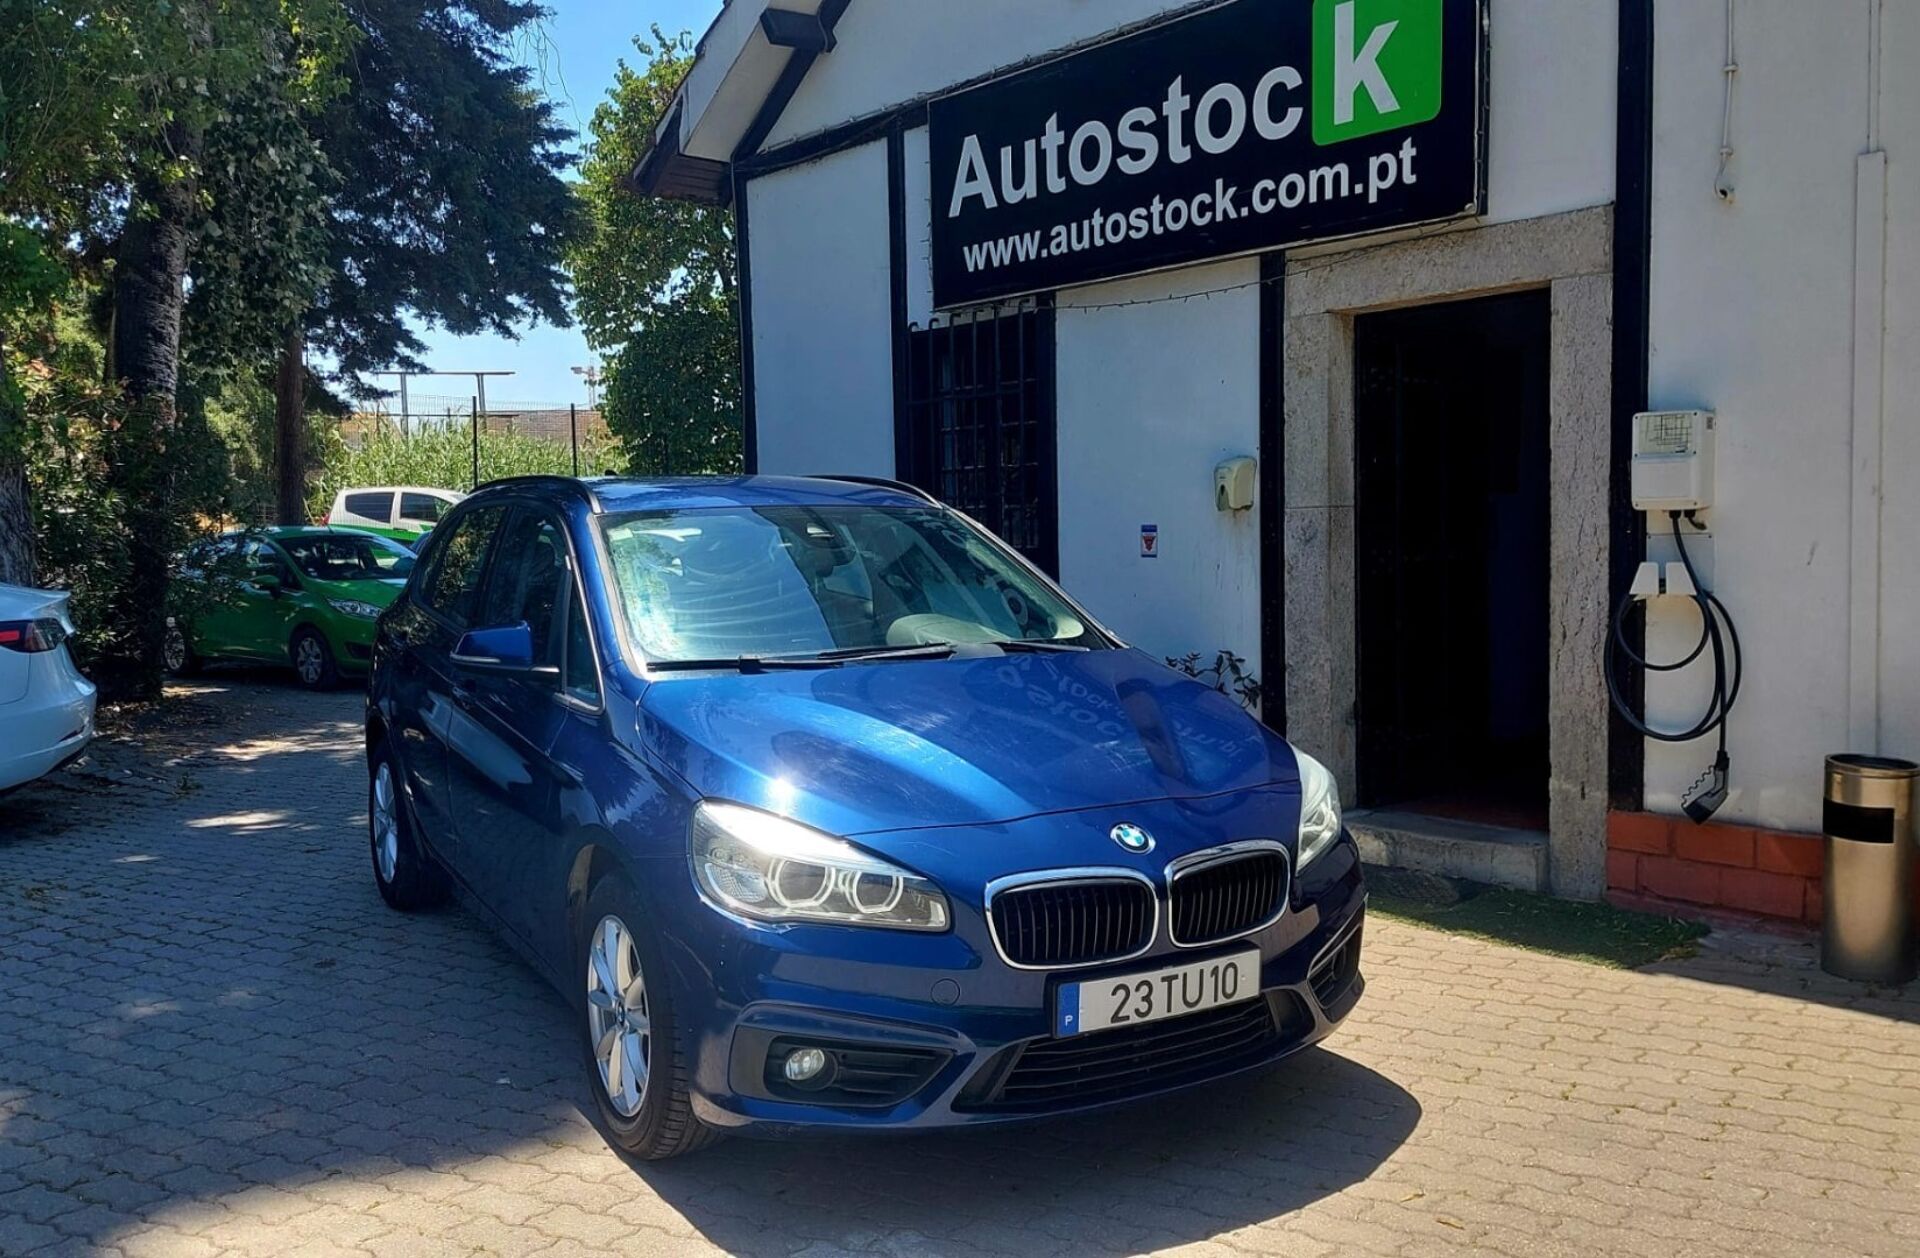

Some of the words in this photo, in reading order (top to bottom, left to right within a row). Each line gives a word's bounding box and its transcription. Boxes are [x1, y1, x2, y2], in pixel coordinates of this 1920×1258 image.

[949, 0, 1401, 218] Autostock
[963, 137, 1417, 272] www.autostock.com.pt
[1064, 1014, 1074, 1027] P
